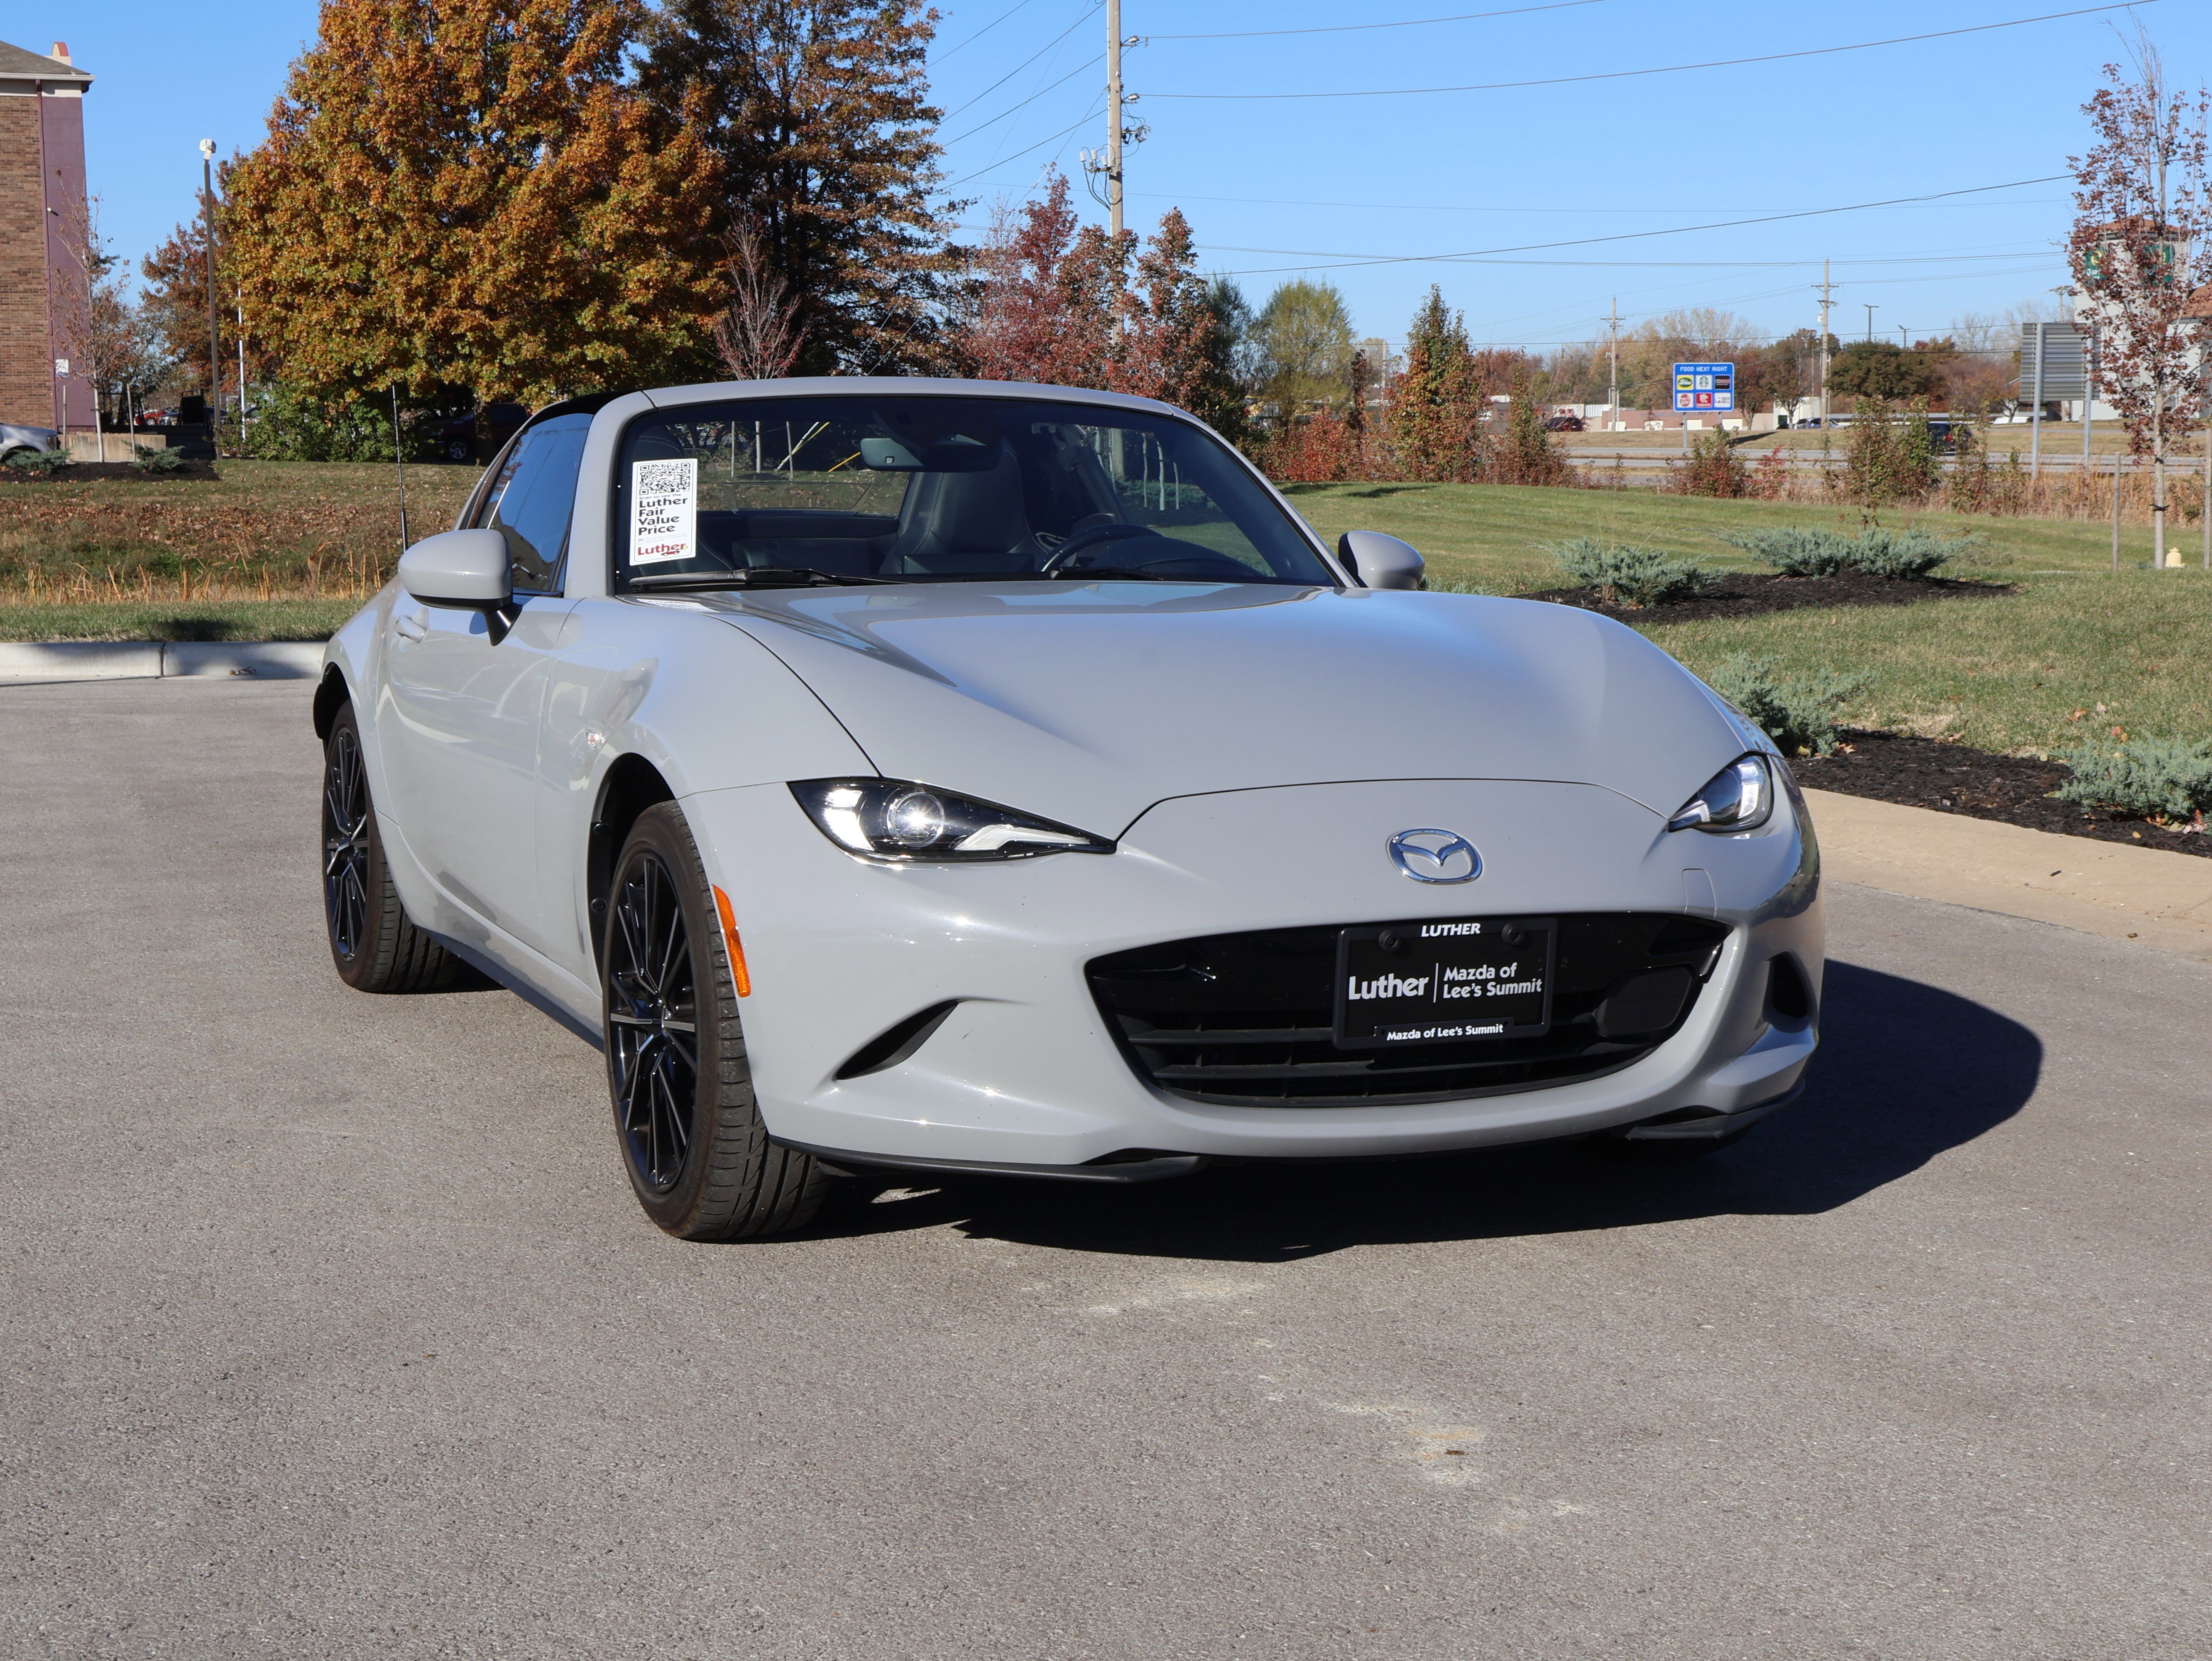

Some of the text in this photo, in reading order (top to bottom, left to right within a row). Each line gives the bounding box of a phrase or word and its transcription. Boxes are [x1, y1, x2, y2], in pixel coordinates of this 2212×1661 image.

[639, 497, 688, 508] Luther
[639, 507, 665, 517] Fair
[638, 516, 680, 526] Value
[639, 525, 675, 536] Price
[638, 543, 686, 556] Luther
[1421, 923, 1481, 937] LUTHER
[1443, 962, 1517, 981] Mazda of
[1348, 973, 1429, 1000] Luther
[1443, 978, 1542, 998] Lee's Summit
[1387, 1023, 1503, 1041] Mazda of Lee's Summit
